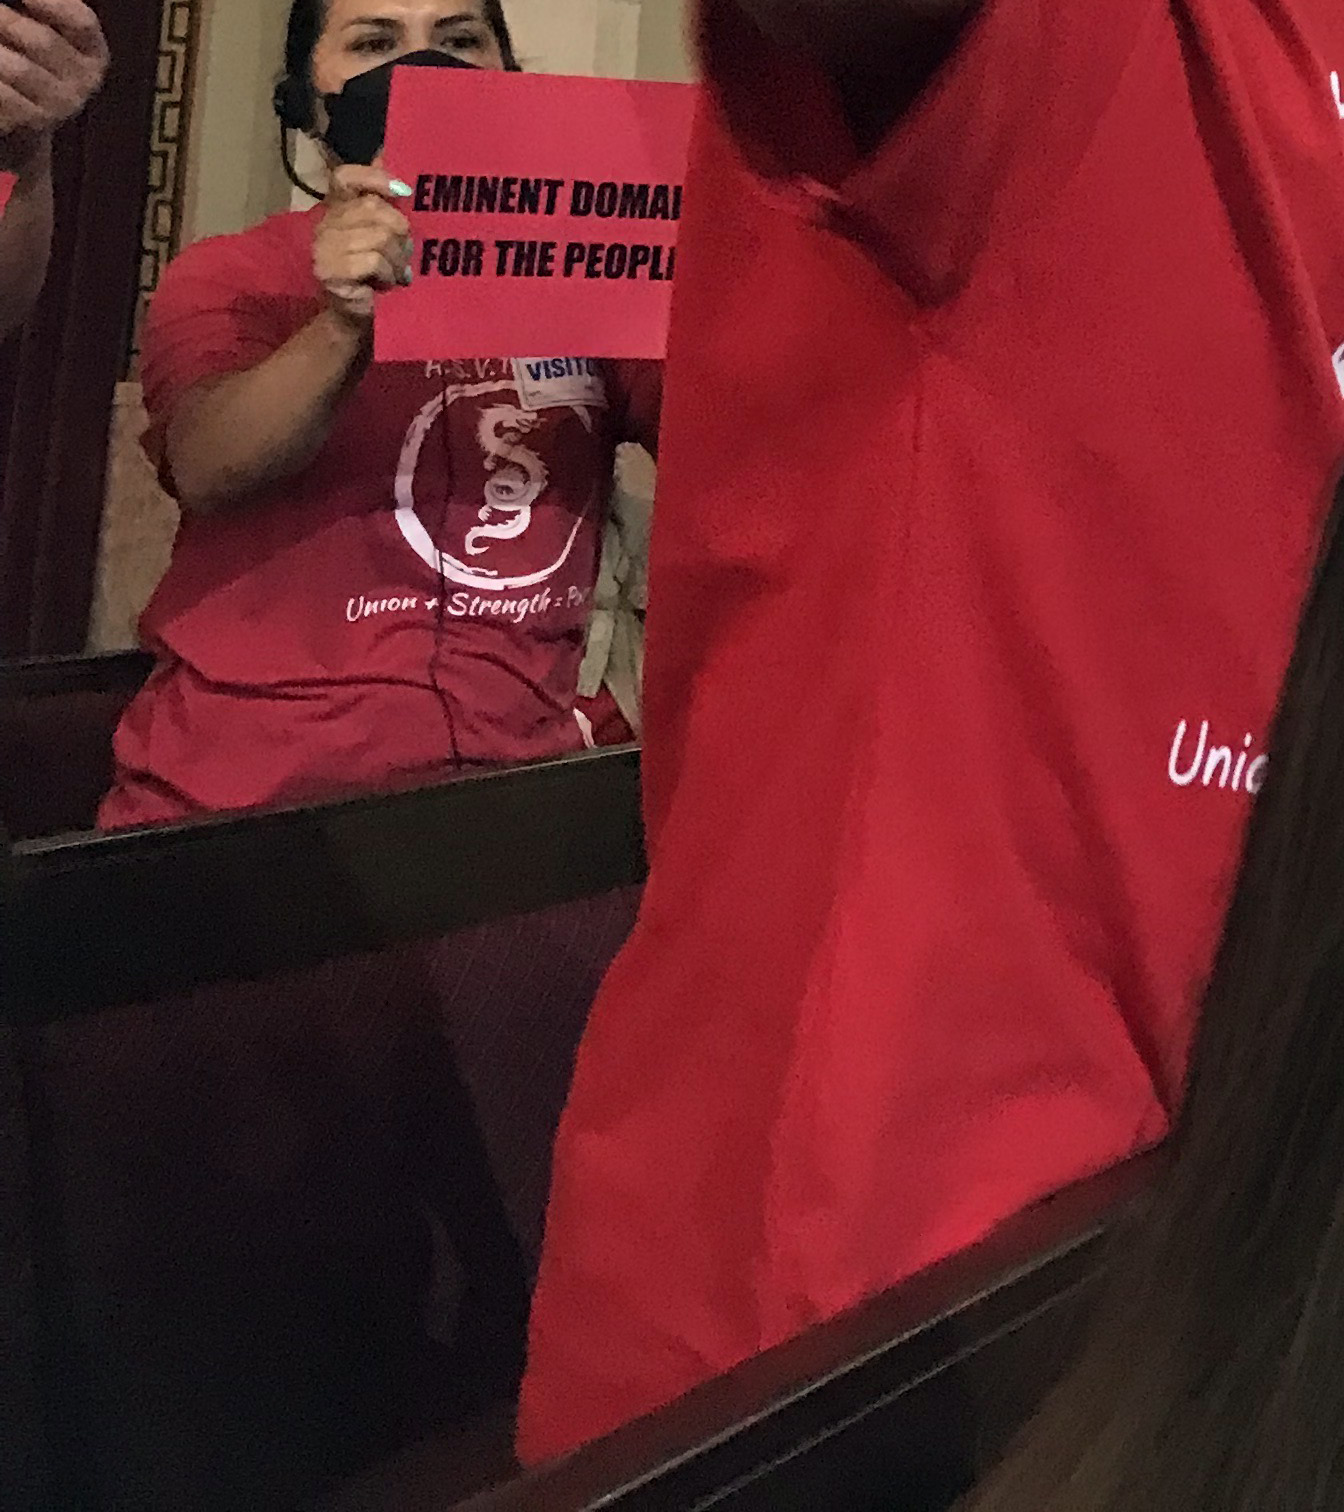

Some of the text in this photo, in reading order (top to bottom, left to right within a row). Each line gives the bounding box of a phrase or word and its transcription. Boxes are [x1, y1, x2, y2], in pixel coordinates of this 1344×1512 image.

[412, 174, 564, 216] EMINENT
[420, 238, 485, 277] FOR
[495, 240, 557, 278] THE
[346, 595, 417, 622] Union
